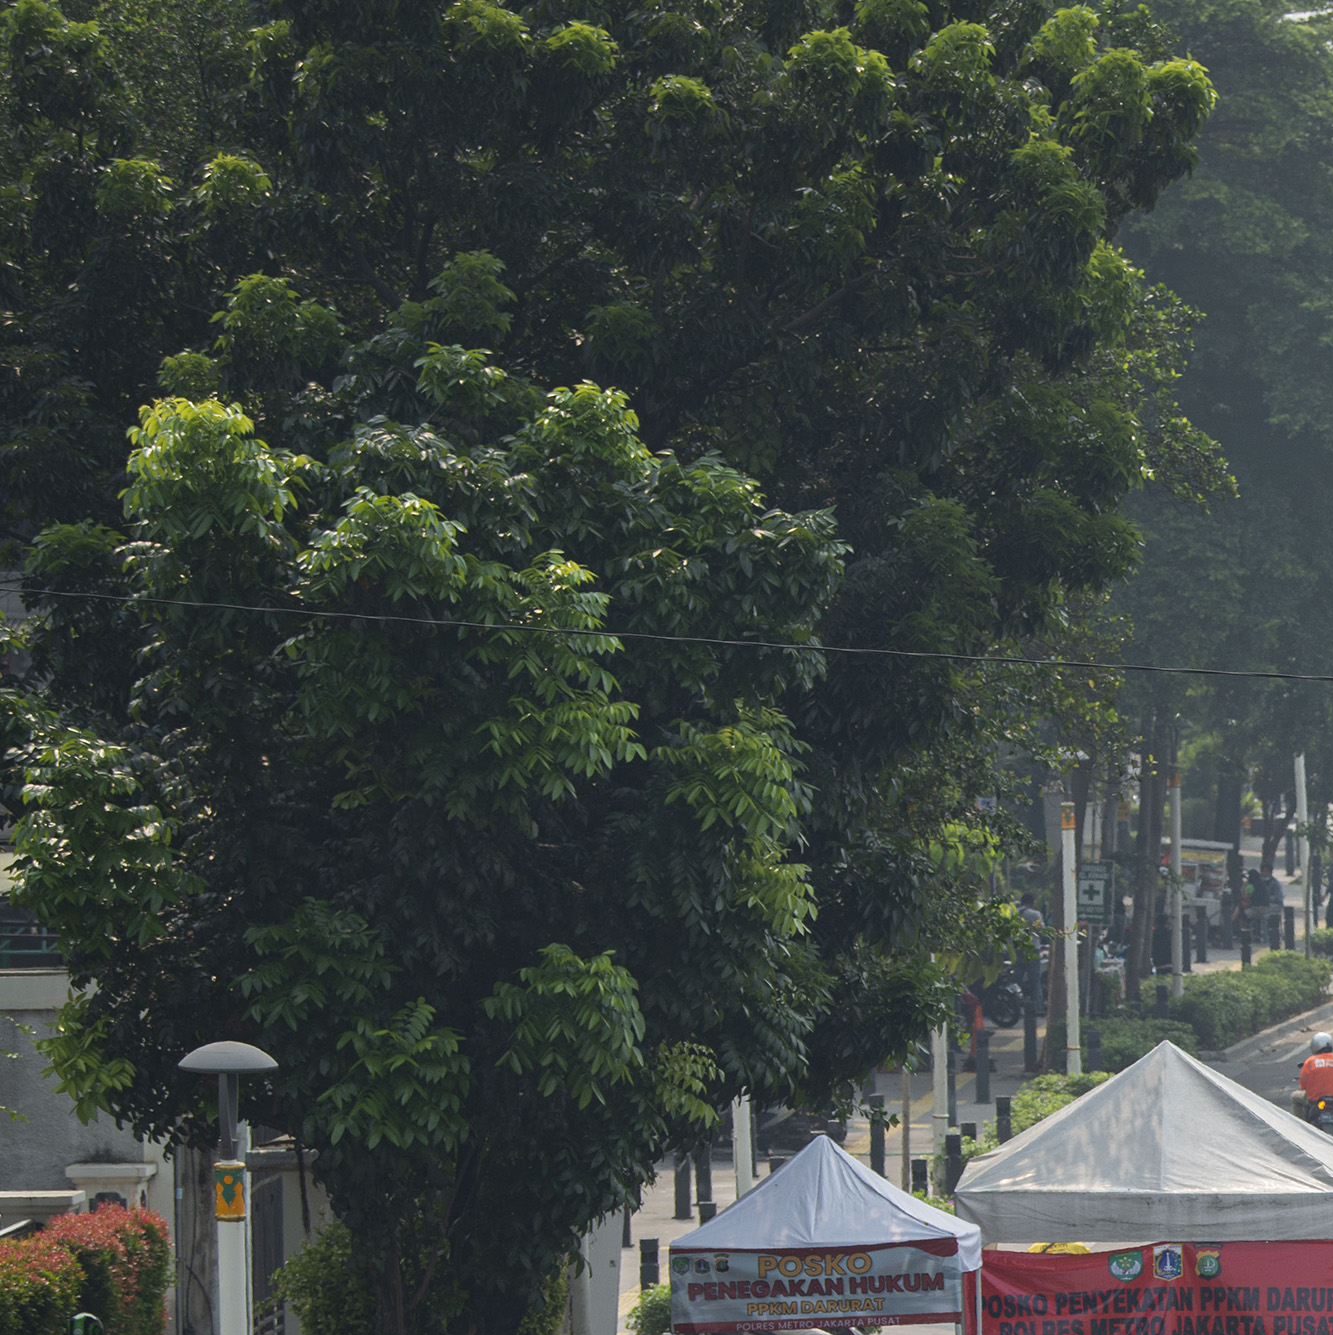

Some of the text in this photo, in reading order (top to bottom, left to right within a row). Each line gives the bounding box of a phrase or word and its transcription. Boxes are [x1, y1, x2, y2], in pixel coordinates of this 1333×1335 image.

[757, 1252, 873, 1279] POSKO
[687, 1272, 945, 1302] PENEGAKAN HUKUM
[746, 1297, 886, 1317] PPKM DARURAT
[1055, 1287, 1193, 1316] PENYEKATAN
[1199, 1286, 1261, 1314] PPKM
[736, 1316, 901, 1332] POLRES METRO JAKARTA PUSAT
